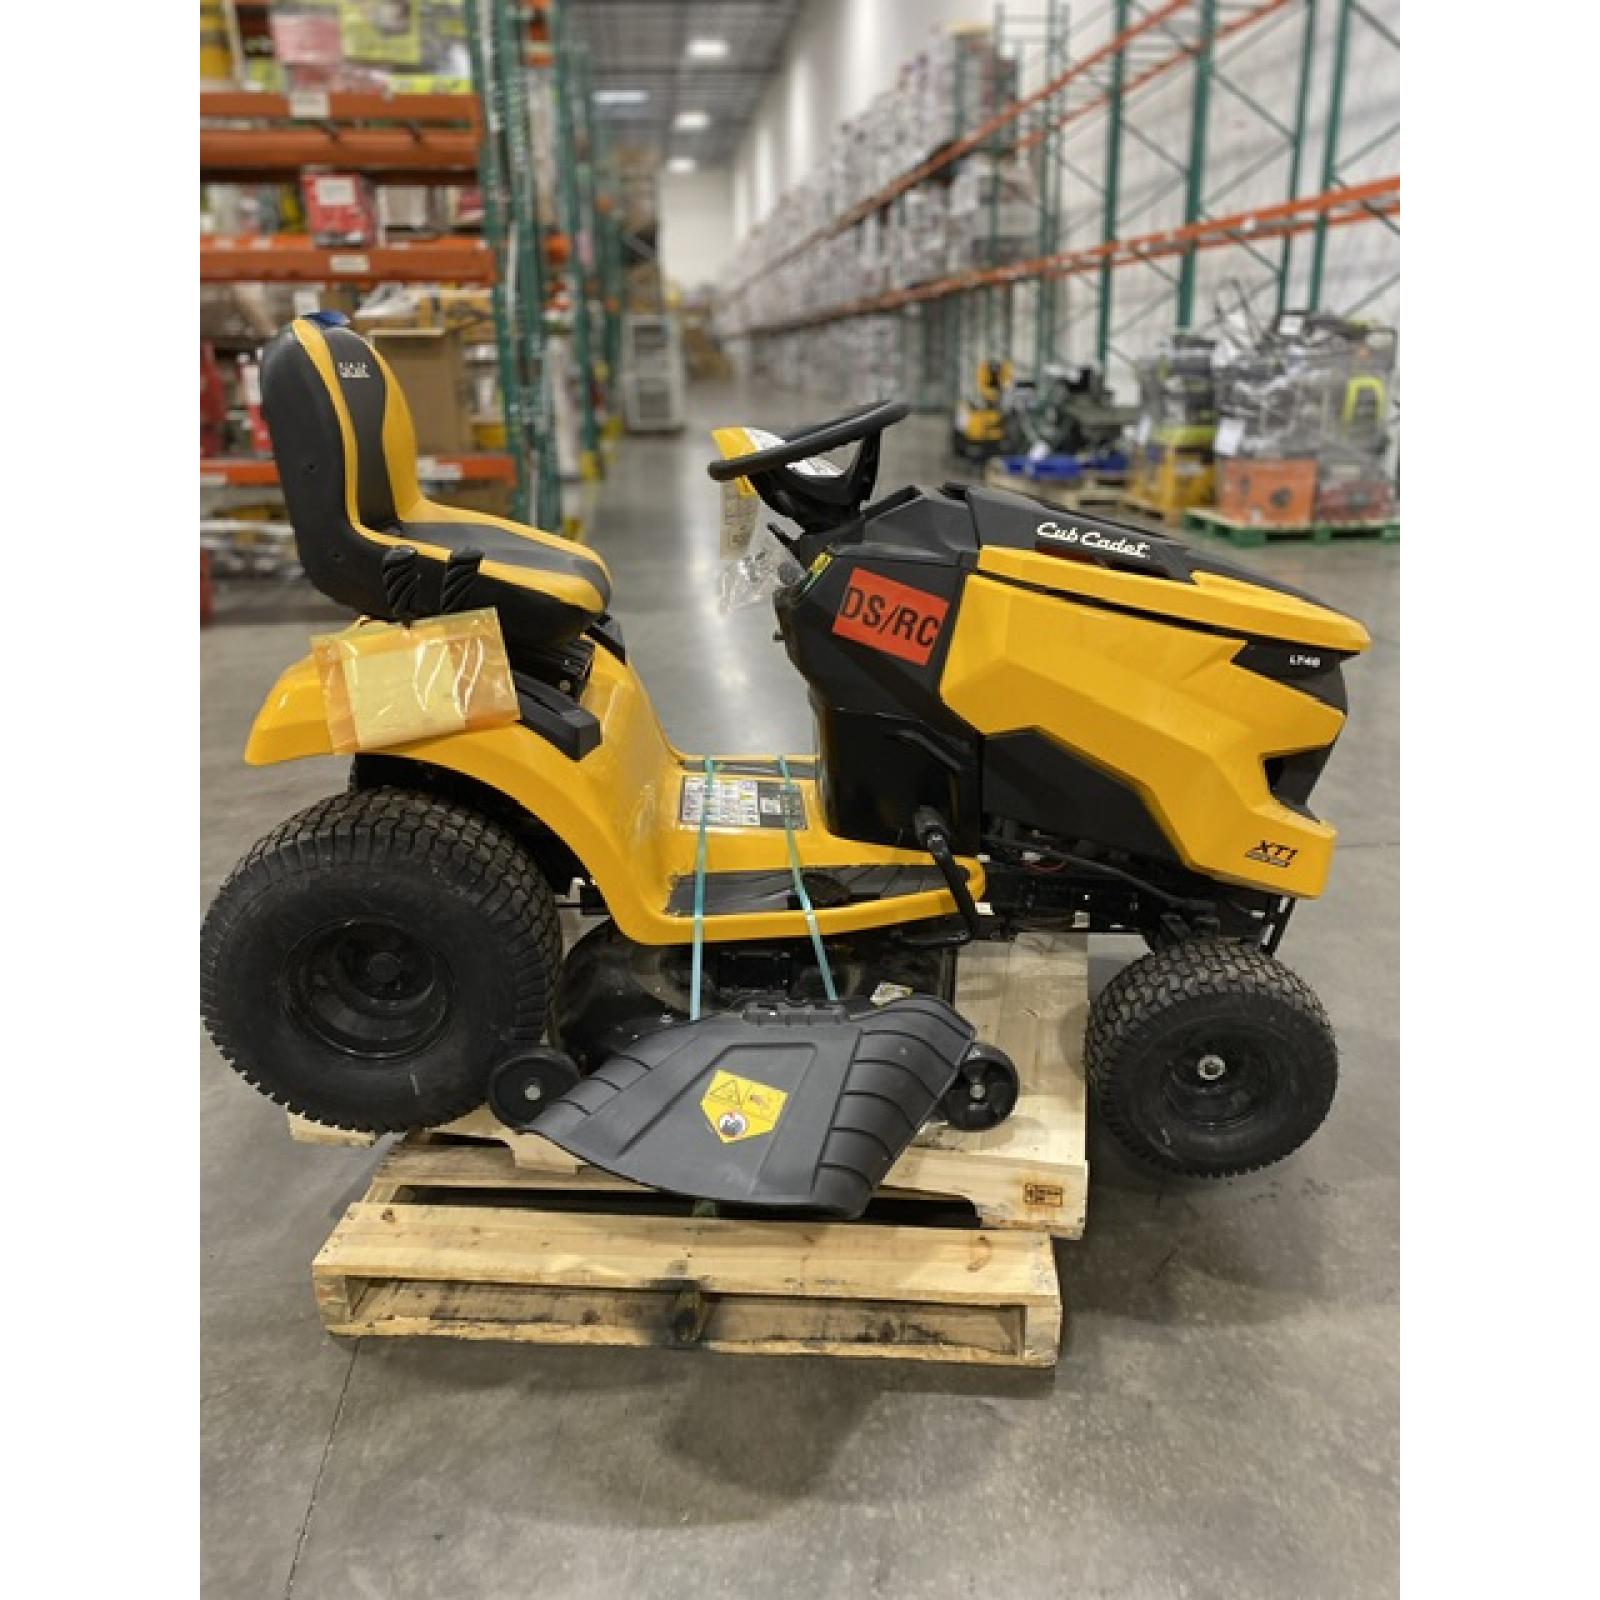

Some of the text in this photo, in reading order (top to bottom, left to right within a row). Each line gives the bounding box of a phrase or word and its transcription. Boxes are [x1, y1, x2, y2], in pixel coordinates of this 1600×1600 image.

[1036, 521, 1150, 558] Cub Cadet
[841, 587, 938, 647] DS/RC
